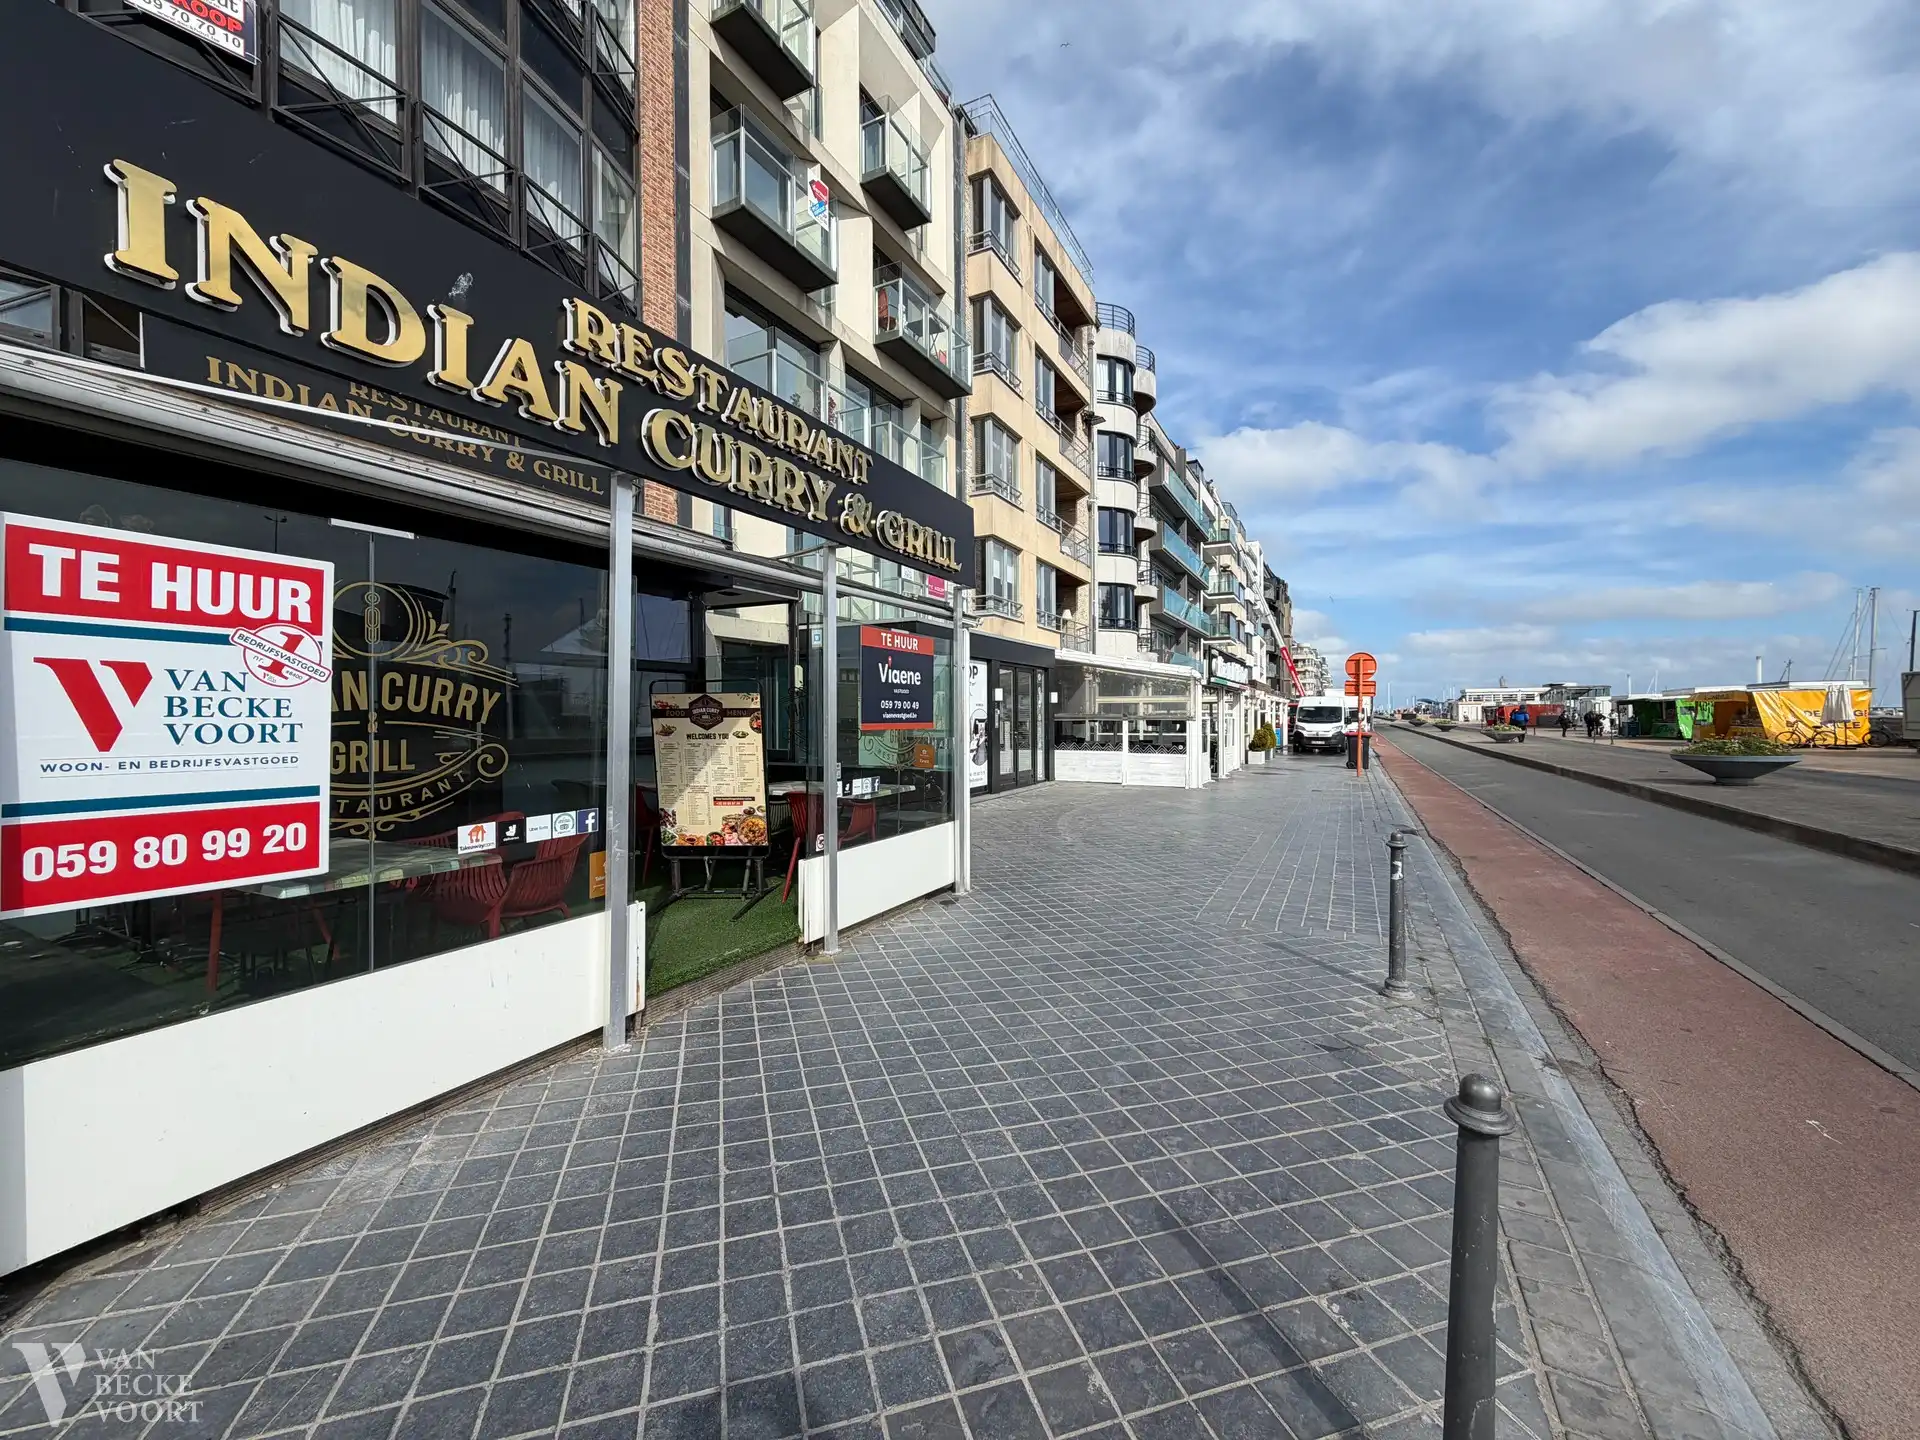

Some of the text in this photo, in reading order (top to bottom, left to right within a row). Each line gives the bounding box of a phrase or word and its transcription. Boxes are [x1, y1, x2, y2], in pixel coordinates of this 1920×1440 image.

[169, 5, 190, 23] 70
[196, 18, 216, 36] 70
[222, 32, 241, 48] 10
[104, 158, 962, 573] INDIAN CURRY & GRILL
[562, 297, 873, 485] RESTAURANT
[206, 355, 604, 496] INDIAN CURRY & GRILL
[28, 543, 312, 623] TE HUUR
[237, 633, 326, 678] BEDRIJFSVASTGOED
[880, 632, 919, 650] TE HUUR
[164, 668, 249, 693] VAN
[878, 658, 921, 686] Viaene
[164, 695, 293, 719] BECKE
[381, 671, 501, 725] CURRY
[880, 700, 920, 710] 059 79 00 49
[164, 722, 303, 745] VOORT
[718, 732, 730, 740] YOU
[40, 756, 300, 773] WOON- EN BEDRIJFSVASTGOED
[330, 739, 416, 775] GRILL
[336, 769, 466, 813] TAURANT
[22, 822, 308, 883] 059 80 99 20
